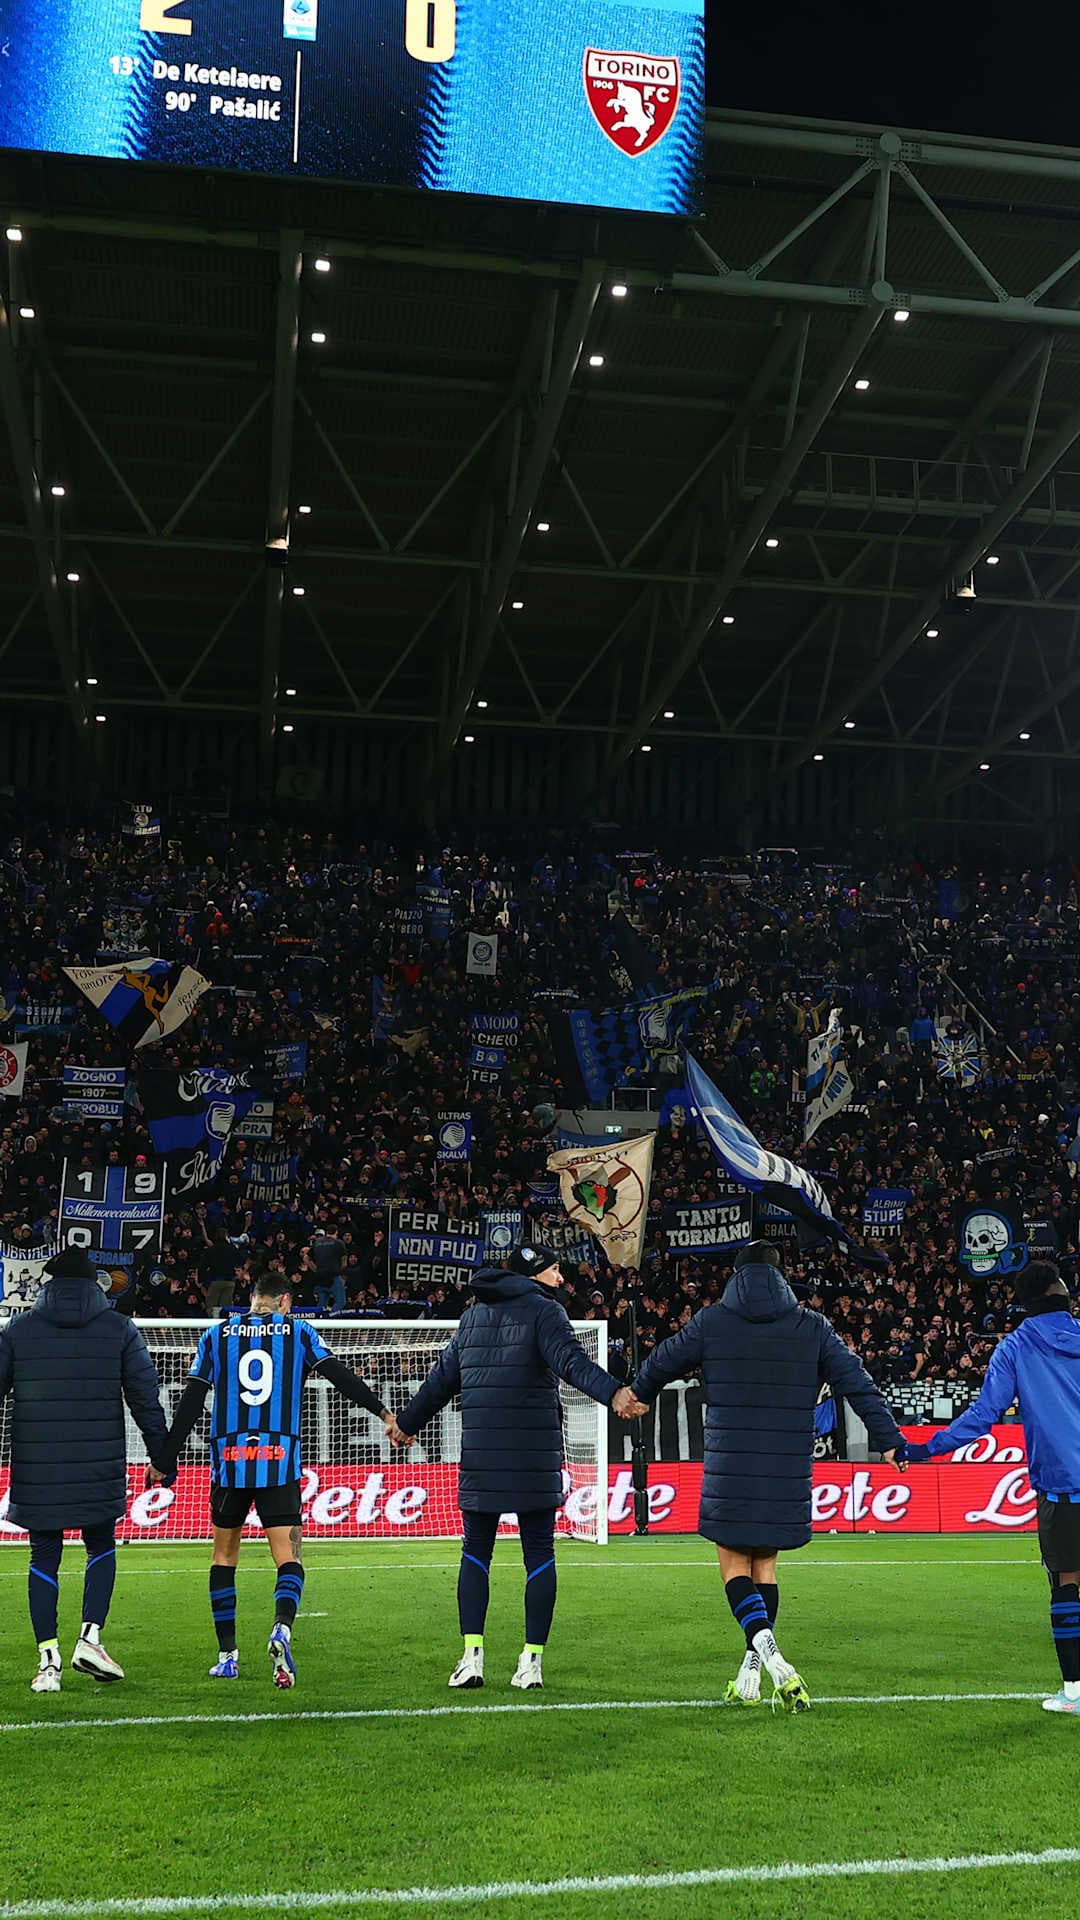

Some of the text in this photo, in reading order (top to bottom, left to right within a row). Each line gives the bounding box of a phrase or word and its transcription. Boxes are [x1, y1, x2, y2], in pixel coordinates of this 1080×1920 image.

[109, 55, 282, 92] 13' De Ketelaere
[594, 58, 670, 80] TORINO
[592, 79, 670, 103] 1906 FC
[165, 91, 281, 121] 90' Pašalić
[73, 1071, 117, 1083] ZOGNO
[81, 1087, 106, 1098] 1907
[437, 1112, 471, 1121] ULTRAS
[399, 1211, 480, 1236] PER CHI
[484, 1212, 521, 1223] RDESIO
[676, 1205, 741, 1227] TANTO
[863, 1207, 904, 1223] STUPE
[666, 1220, 751, 1247] TORNANO
[398, 1237, 434, 1257] NON
[222, 1323, 291, 1338] SCAMACCA
[238, 1349, 274, 1407] 9
[300, 1469, 428, 1528] ete
[560, 1470, 676, 1523] ete
[812, 1471, 911, 1522] ete
